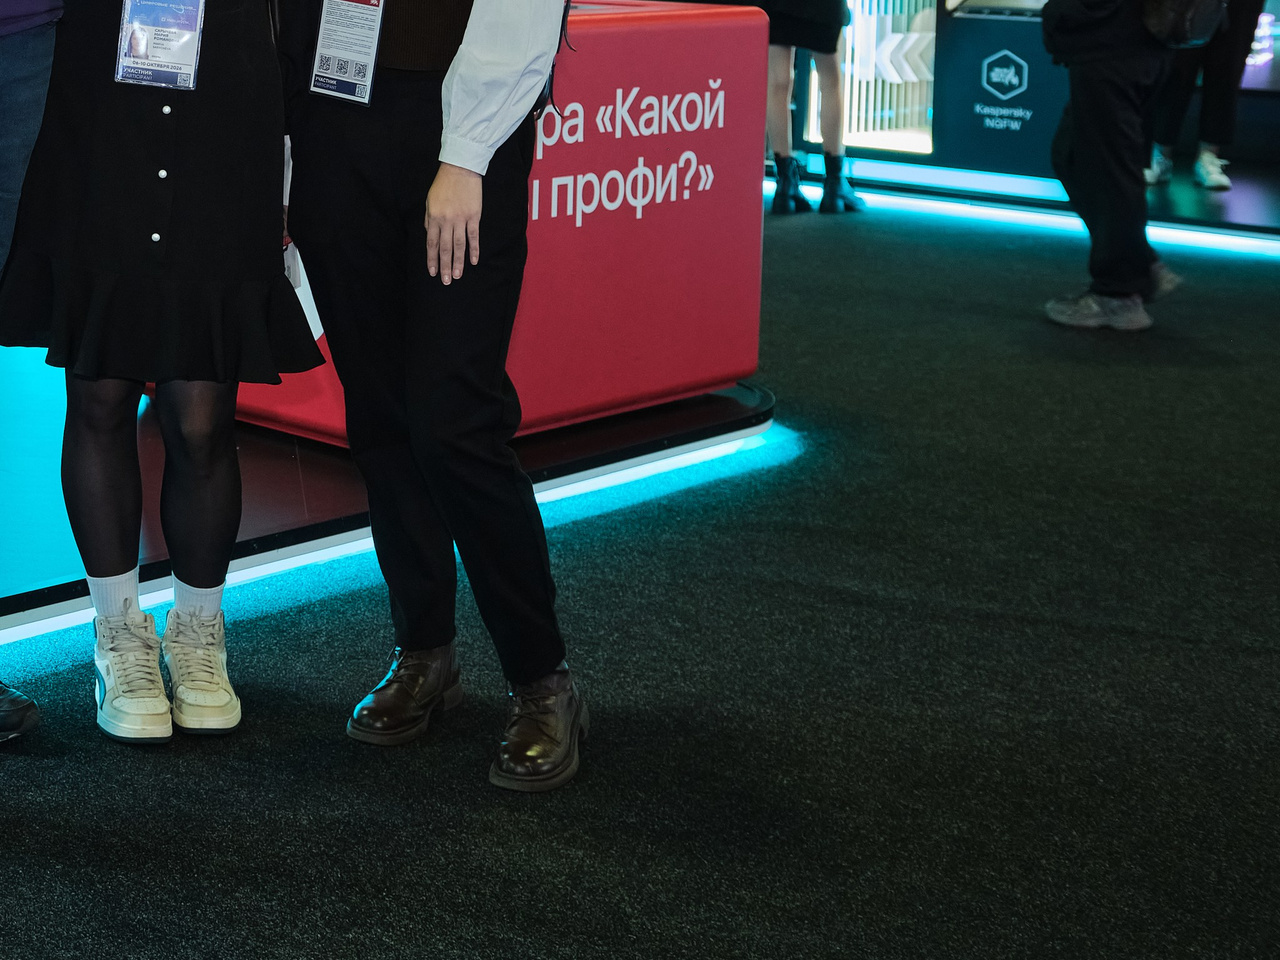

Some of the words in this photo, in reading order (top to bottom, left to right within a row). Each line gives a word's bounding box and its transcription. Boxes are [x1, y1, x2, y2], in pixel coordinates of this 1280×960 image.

[535, 100, 585, 161] ра
[595, 78, 726, 139] «Какой
[973, 102, 1033, 121] Kaspersky
[550, 150, 715, 228] профи?»
